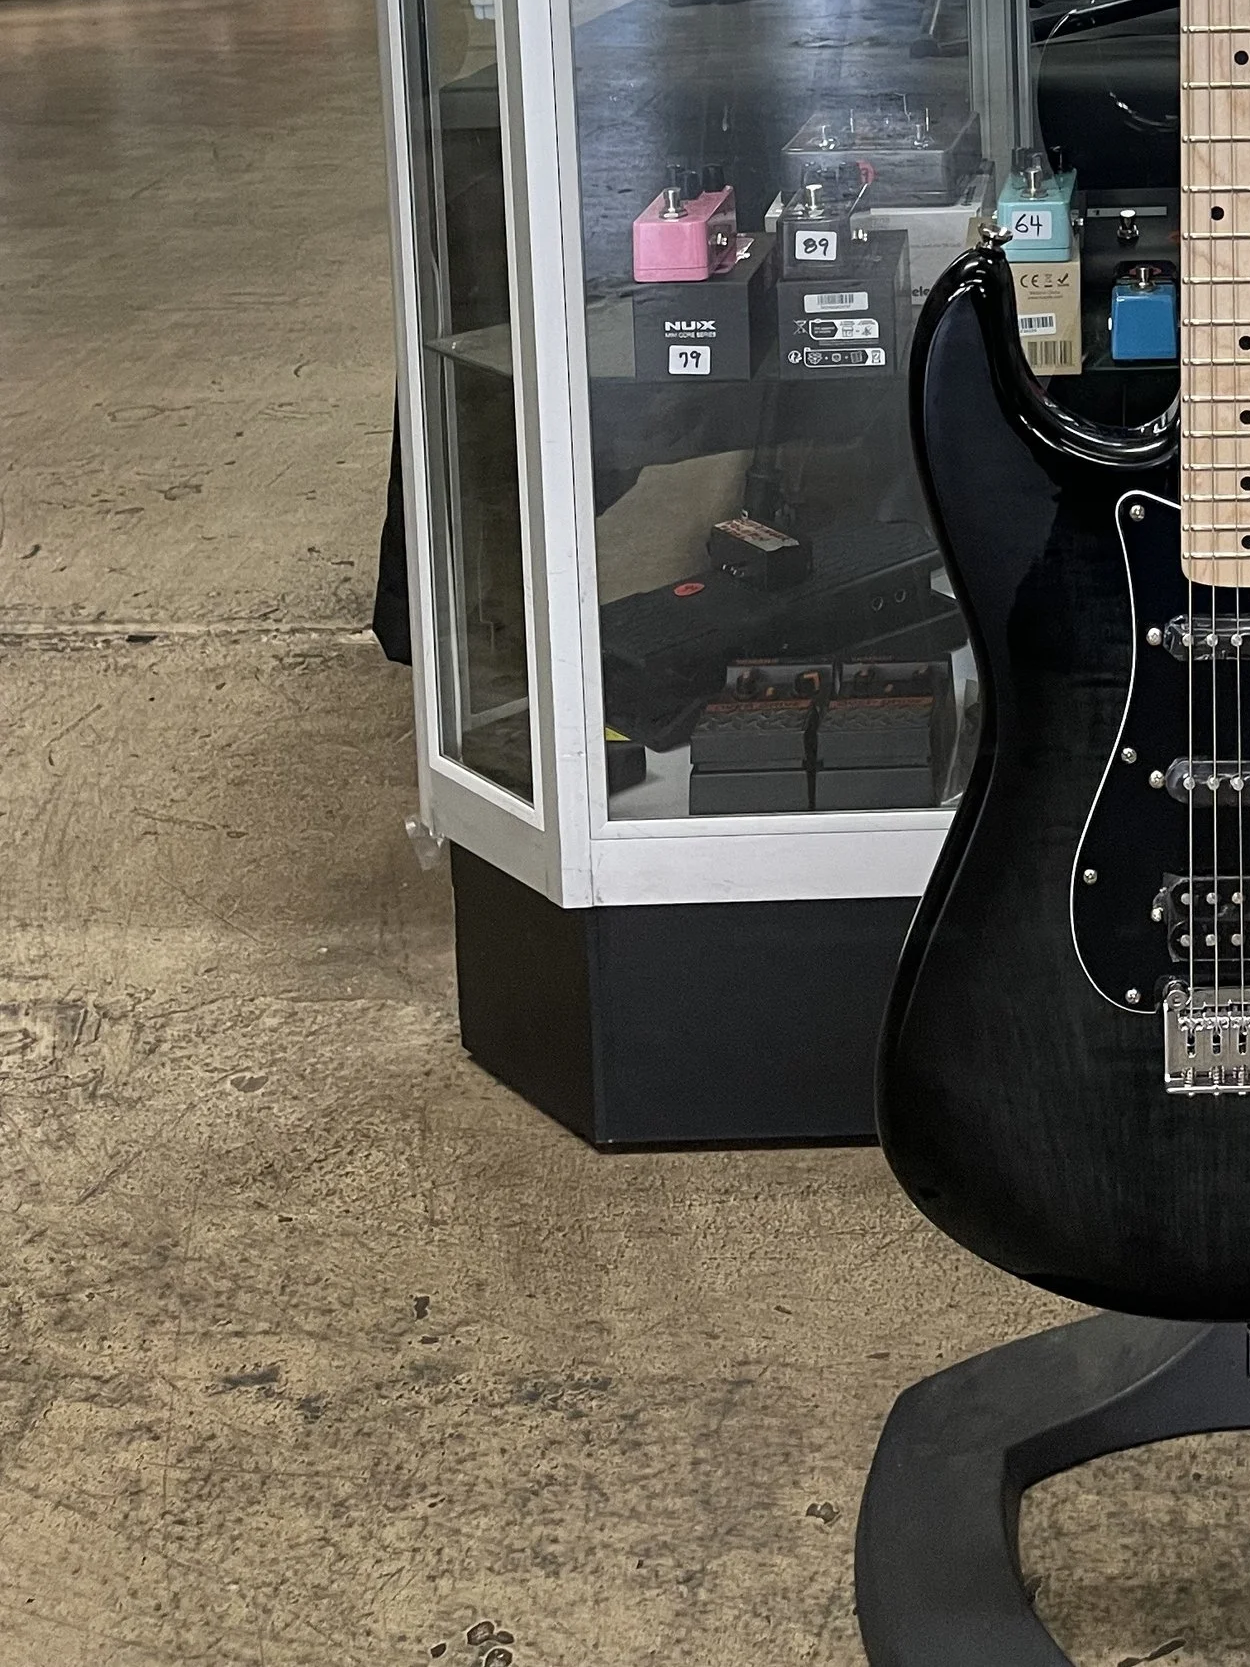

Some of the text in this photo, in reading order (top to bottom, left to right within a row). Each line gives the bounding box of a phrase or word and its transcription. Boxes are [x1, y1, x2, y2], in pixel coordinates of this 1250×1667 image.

[1014, 213, 1043, 237] 64
[665, 320, 717, 332] NUX
[679, 350, 702, 369] 79
